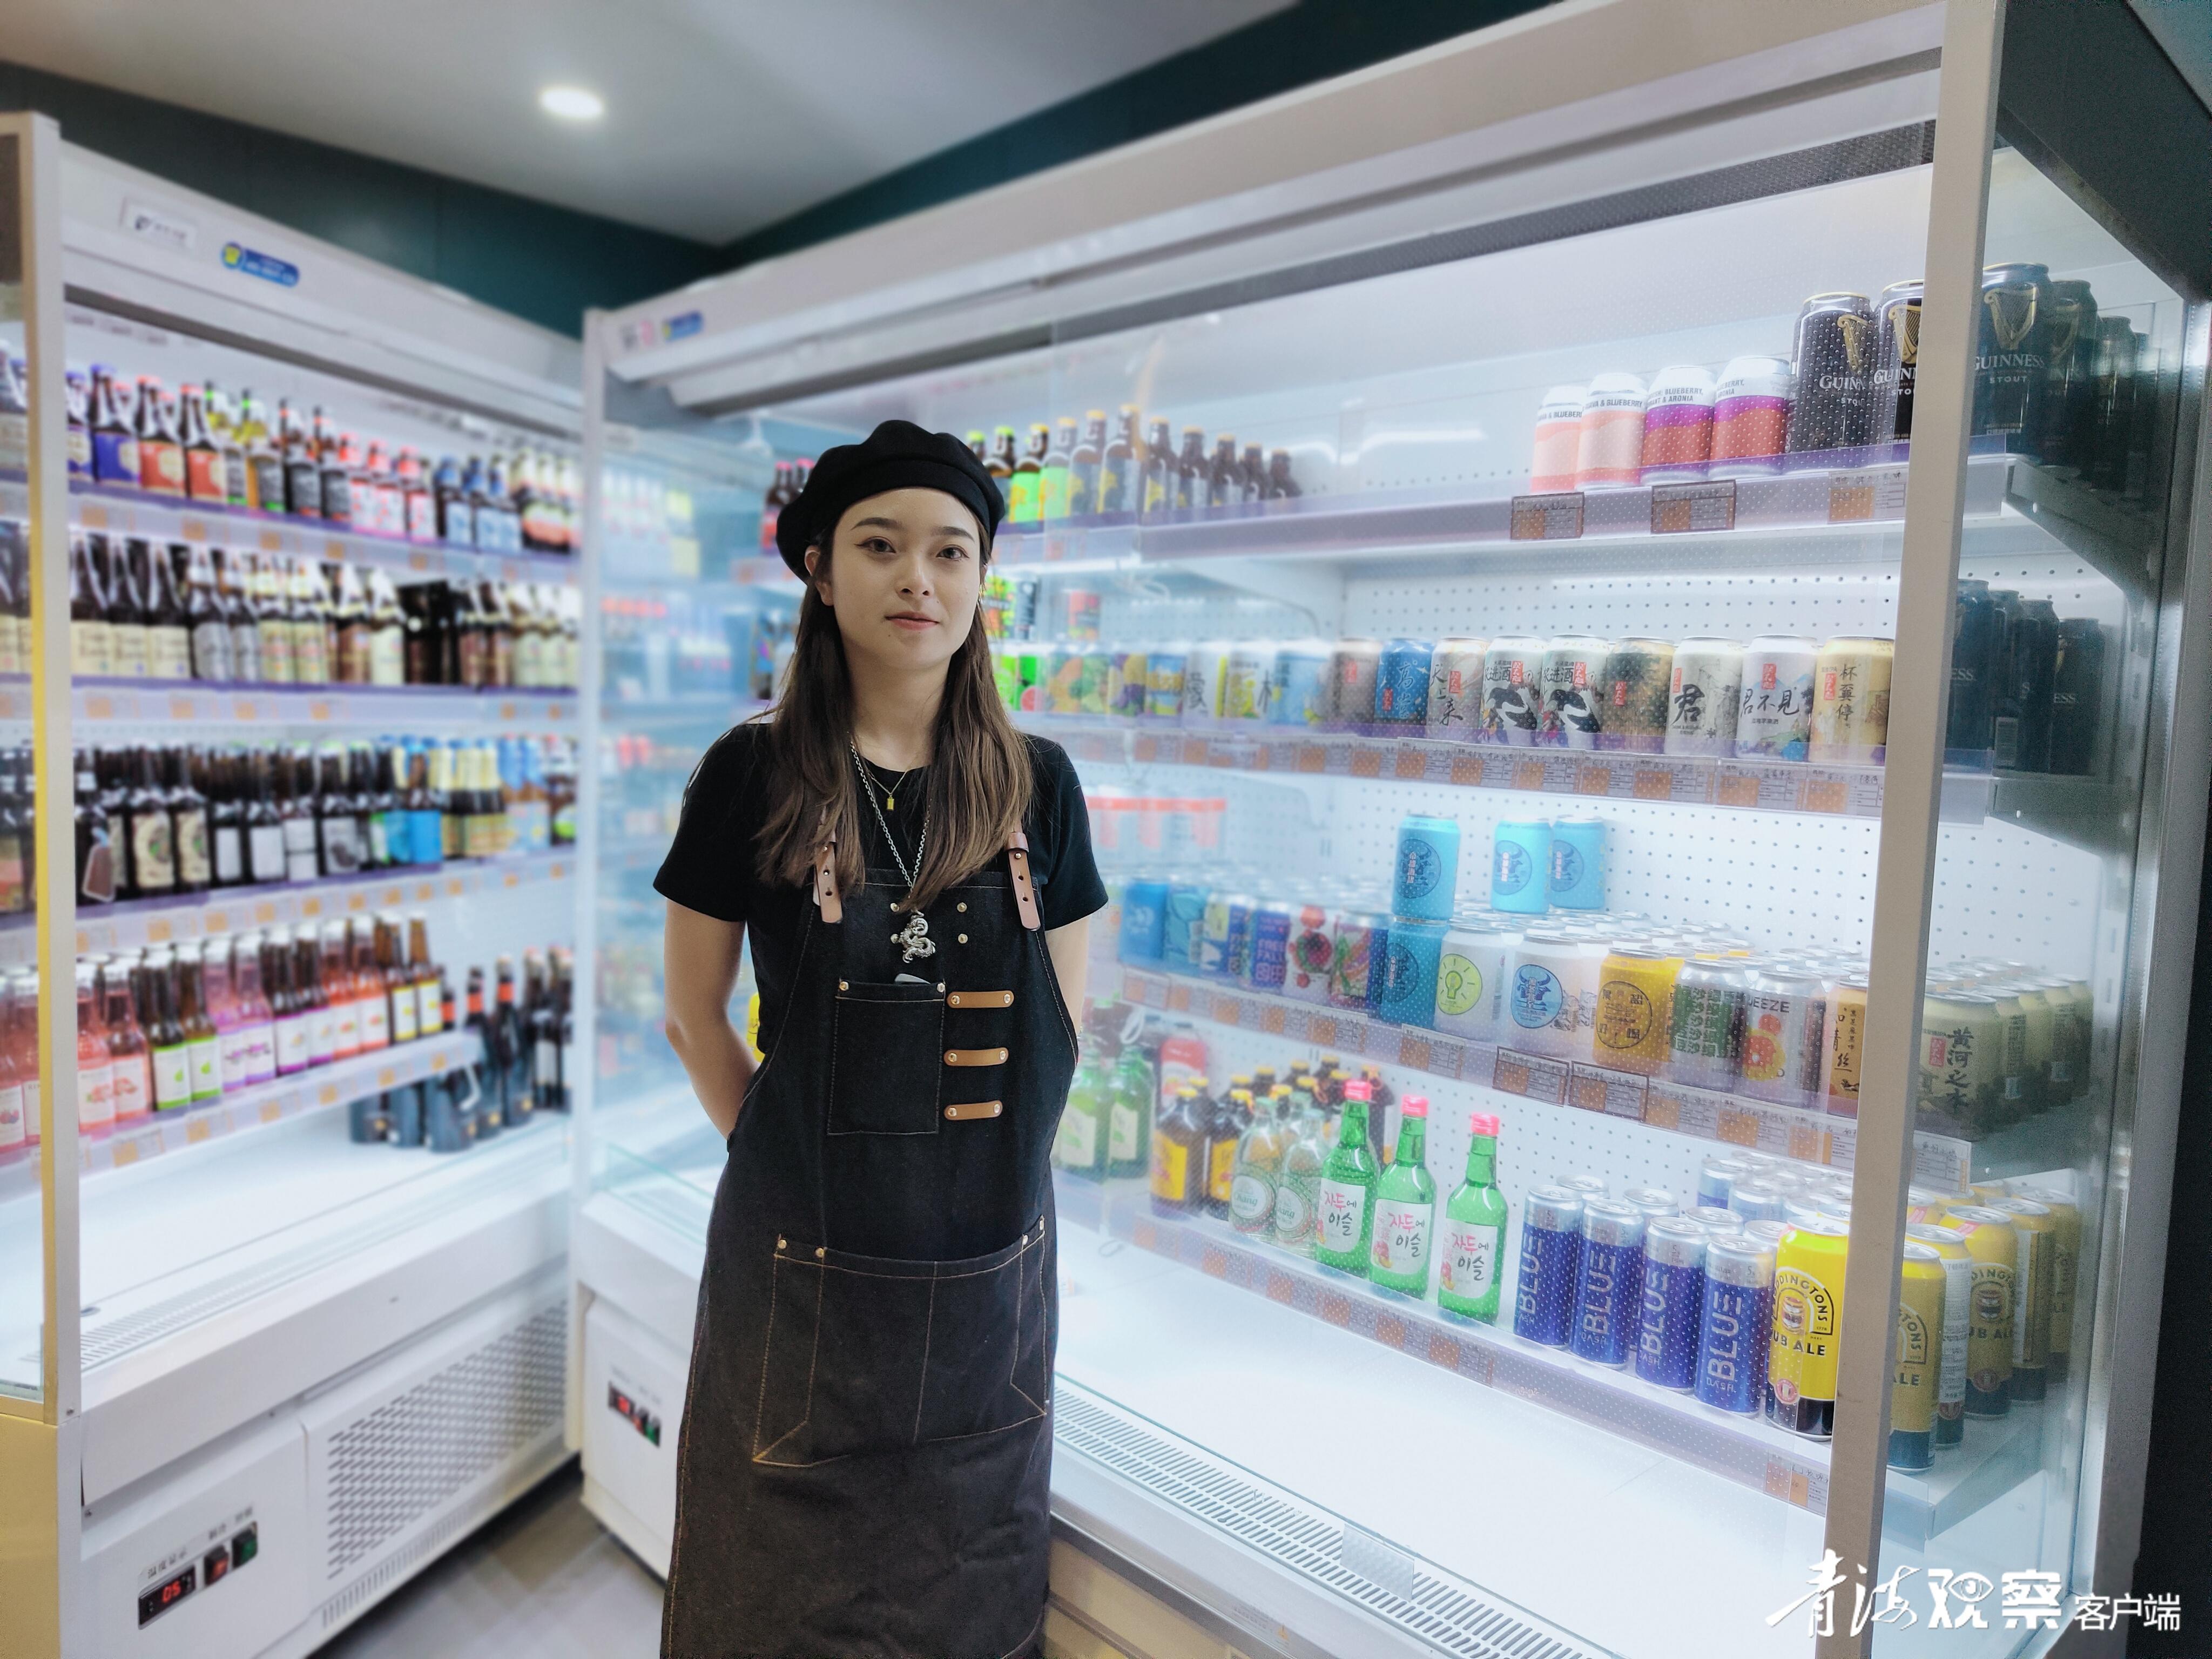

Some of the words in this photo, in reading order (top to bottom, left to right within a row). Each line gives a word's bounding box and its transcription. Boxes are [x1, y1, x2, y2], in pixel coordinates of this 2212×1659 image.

[1990, 375, 2027, 384] STOUT
[1607, 399, 1642, 408] BLUEBERRY
[1670, 684, 1705, 726] 君
[1741, 689, 1799, 718] 君不见
[1945, 1026, 1974, 1107] 黄河之水
[1324, 1191, 1357, 1212] 자두에
[1328, 1212, 1353, 1236] 이슬
[1387, 1212, 1425, 1233] 자두에
[1395, 1232, 1421, 1257] 이슬
[1451, 1232, 1489, 1255] 자두에
[1458, 1255, 1485, 1281] 이슬
[1518, 1232, 1543, 1314] BLUE
[1582, 1250, 1616, 1334] BLUE
[1775, 1273, 1828, 1321] DDINGTONS
[1640, 1267, 1668, 1355] BLUE
[1581, 1332, 1607, 1345] DASH
[1708, 1291, 1742, 1381] BLUE
[1772, 1333, 1788, 1346] UB
[1793, 1340, 1826, 1356] ALE
[1706, 1377, 1734, 1392] DASH
[1893, 1373, 1921, 1386] LE
